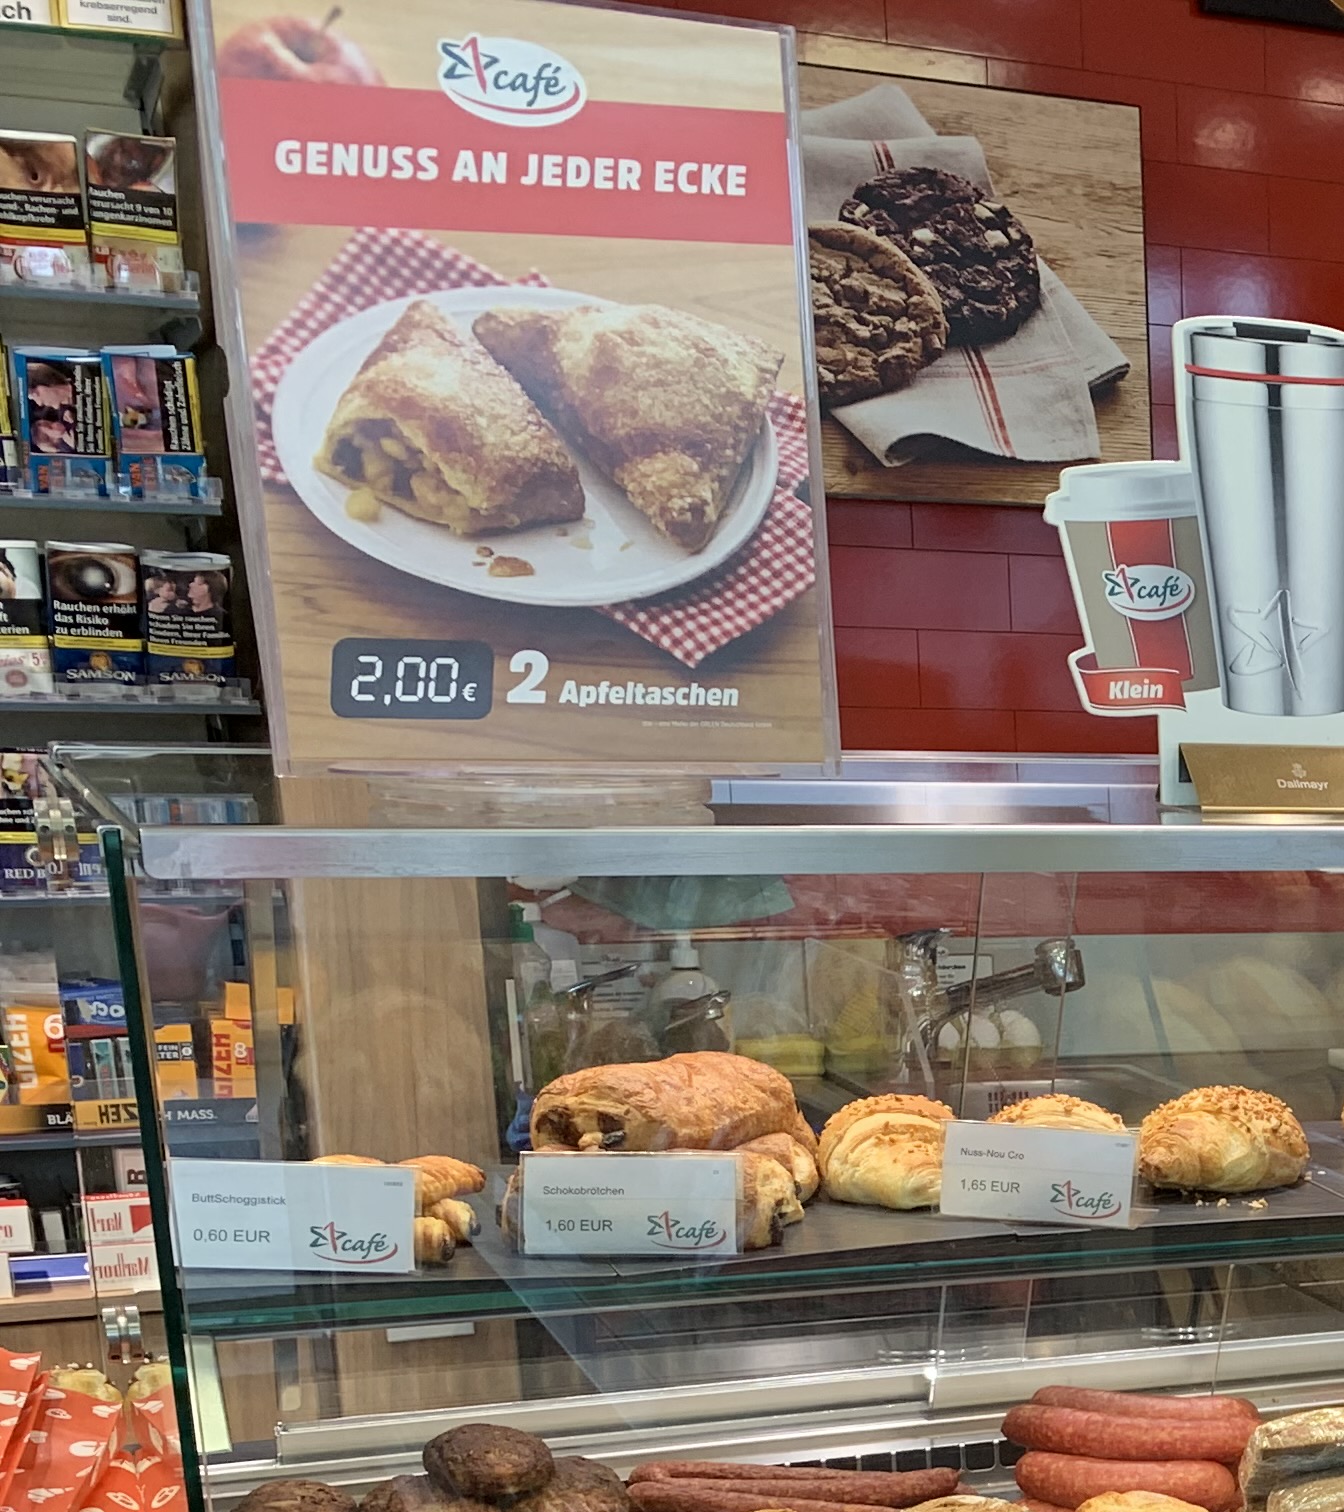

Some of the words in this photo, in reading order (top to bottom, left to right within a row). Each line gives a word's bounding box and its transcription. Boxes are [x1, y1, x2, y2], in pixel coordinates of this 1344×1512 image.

[275, 140, 439, 180] GENUSS
[452, 150, 507, 185] AN
[520, 154, 642, 191] JEDER
[654, 161, 747, 196] ECKE
[130, 463, 142, 487] VAN
[1138, 576, 1183, 603] café
[54, 600, 100, 612] Rauchen
[103, 603, 137, 614] erhöht
[54, 612, 73, 623] das
[76, 614, 109, 625] Risiko
[55, 625, 69, 635] zu
[71, 626, 123, 638] erblinden
[66, 668, 136, 681] SAMSON
[506, 649, 549, 704] 2
[559, 680, 739, 707] Apfeltaschen
[1108, 679, 1164, 700] Klein
[1276, 778, 1329, 792] Dallmayr
[178, 1109, 217, 1121] MASS.
[960, 1147, 1005, 1159] Nuss-Nou
[1008, 1151, 1025, 1160] Cro
[543, 1186, 624, 1195] Schokobrötchen
[960, 1179, 987, 1191] 1,65
[991, 1180, 1020, 1193] EUR
[192, 1193, 286, 1206] ButtSchoggistick
[1075, 1192, 1114, 1215] café
[546, 1219, 575, 1233] 1,60
[580, 1219, 613, 1231] EUR
[676, 1220, 718, 1245] café
[193, 1229, 228, 1243] 0,60
[233, 1230, 271, 1243] EUR
[341, 1232, 389, 1259] café
